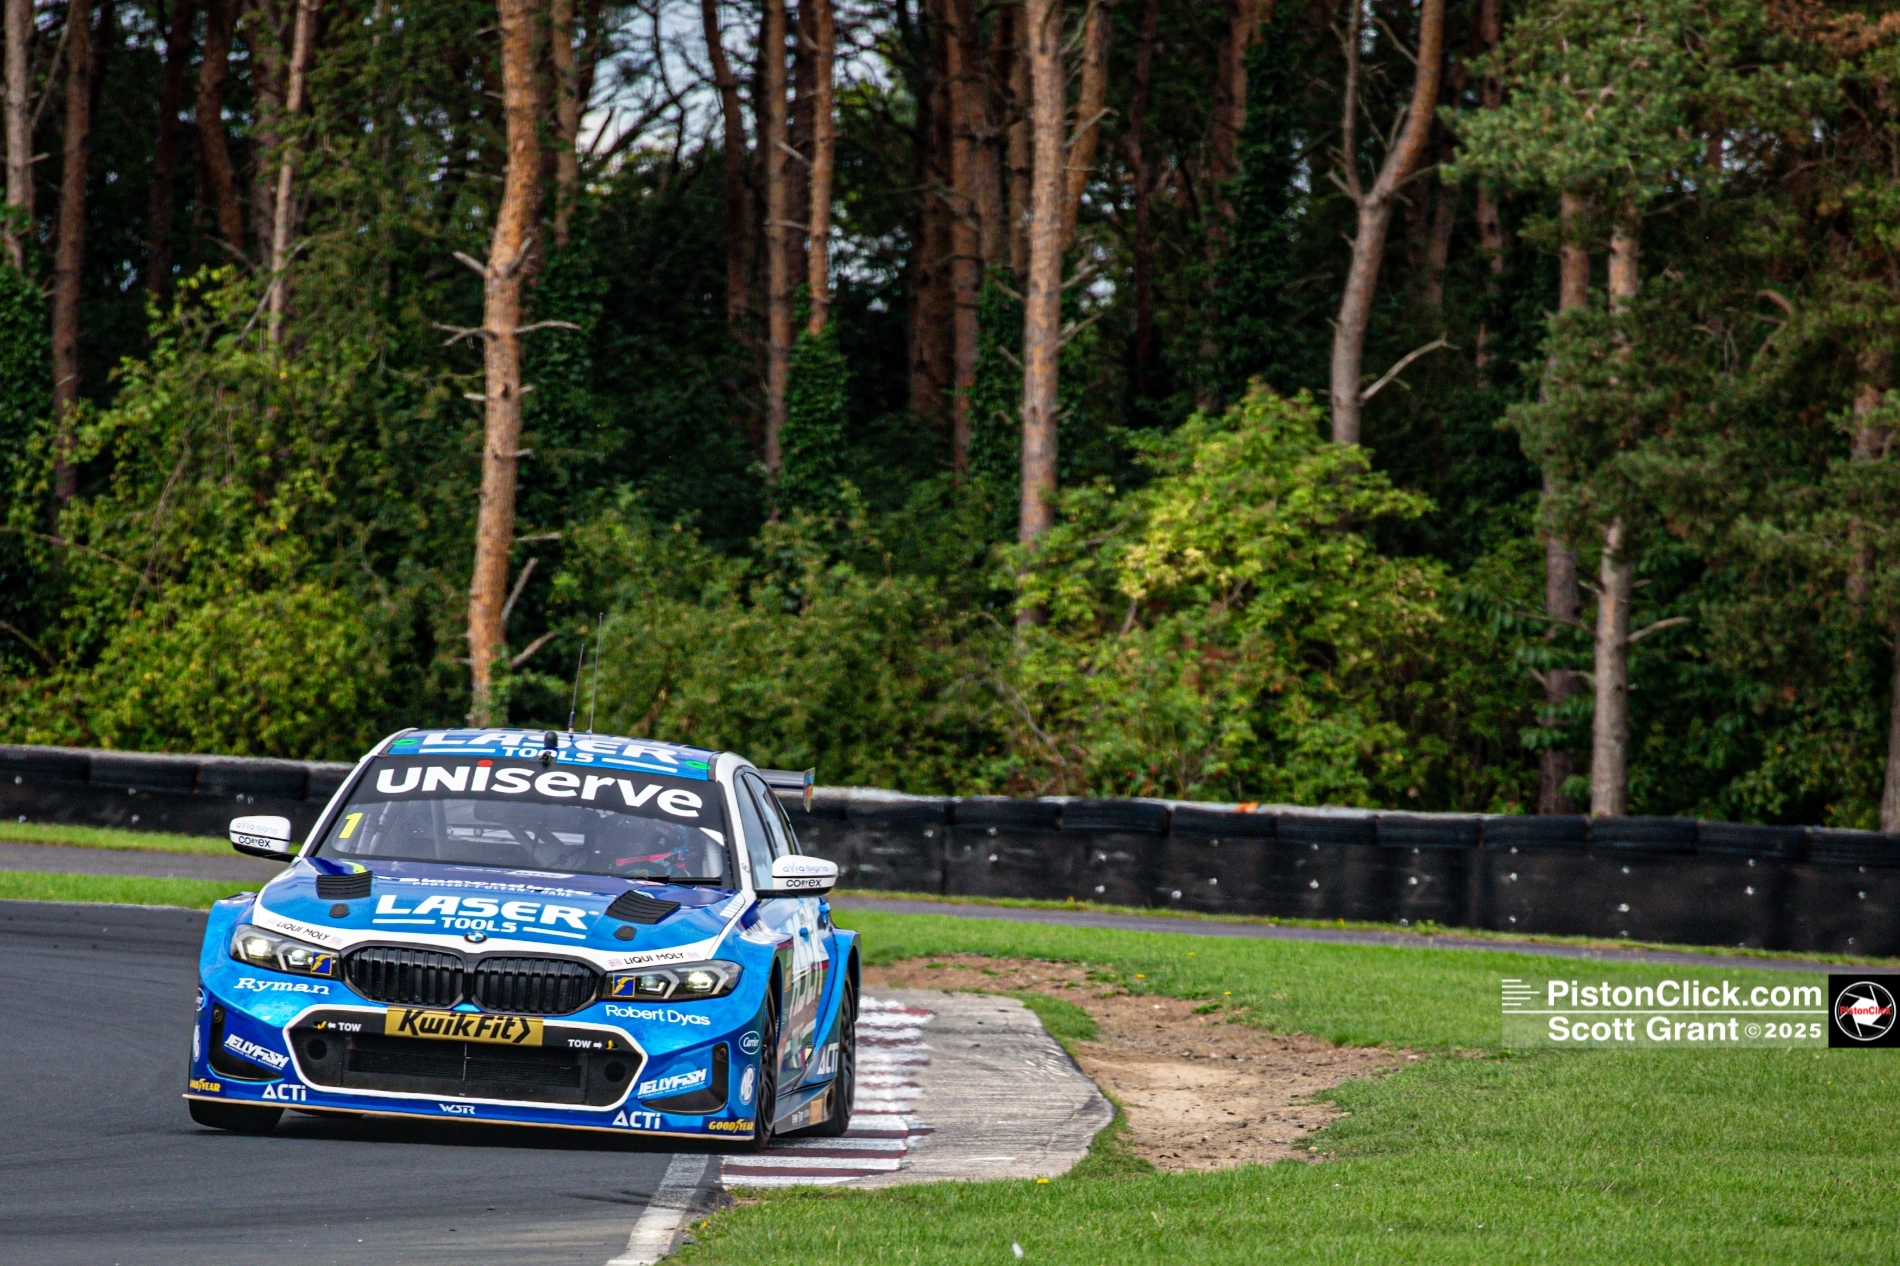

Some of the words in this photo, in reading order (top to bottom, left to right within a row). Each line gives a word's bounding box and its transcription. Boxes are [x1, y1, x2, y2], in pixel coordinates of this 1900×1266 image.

[502, 746, 595, 763] TOOLS
[338, 812, 364, 839] 1
[276, 921, 303, 933] LIQUI
[303, 928, 331, 941] MOLY
[441, 916, 518, 933] TOOLS
[623, 955, 653, 965] LIQUI
[656, 952, 685, 961] MOLY
[233, 977, 330, 996] Ryman
[605, 1005, 665, 1022] Robert
[667, 1010, 711, 1026] Dyas
[338, 1022, 362, 1032] TOW
[224, 1033, 290, 1068] JELLYFISH
[568, 1039, 592, 1049] TOW
[637, 1068, 708, 1096] JELLYFISH
[708, 1118, 755, 1134] GOODYEAR
